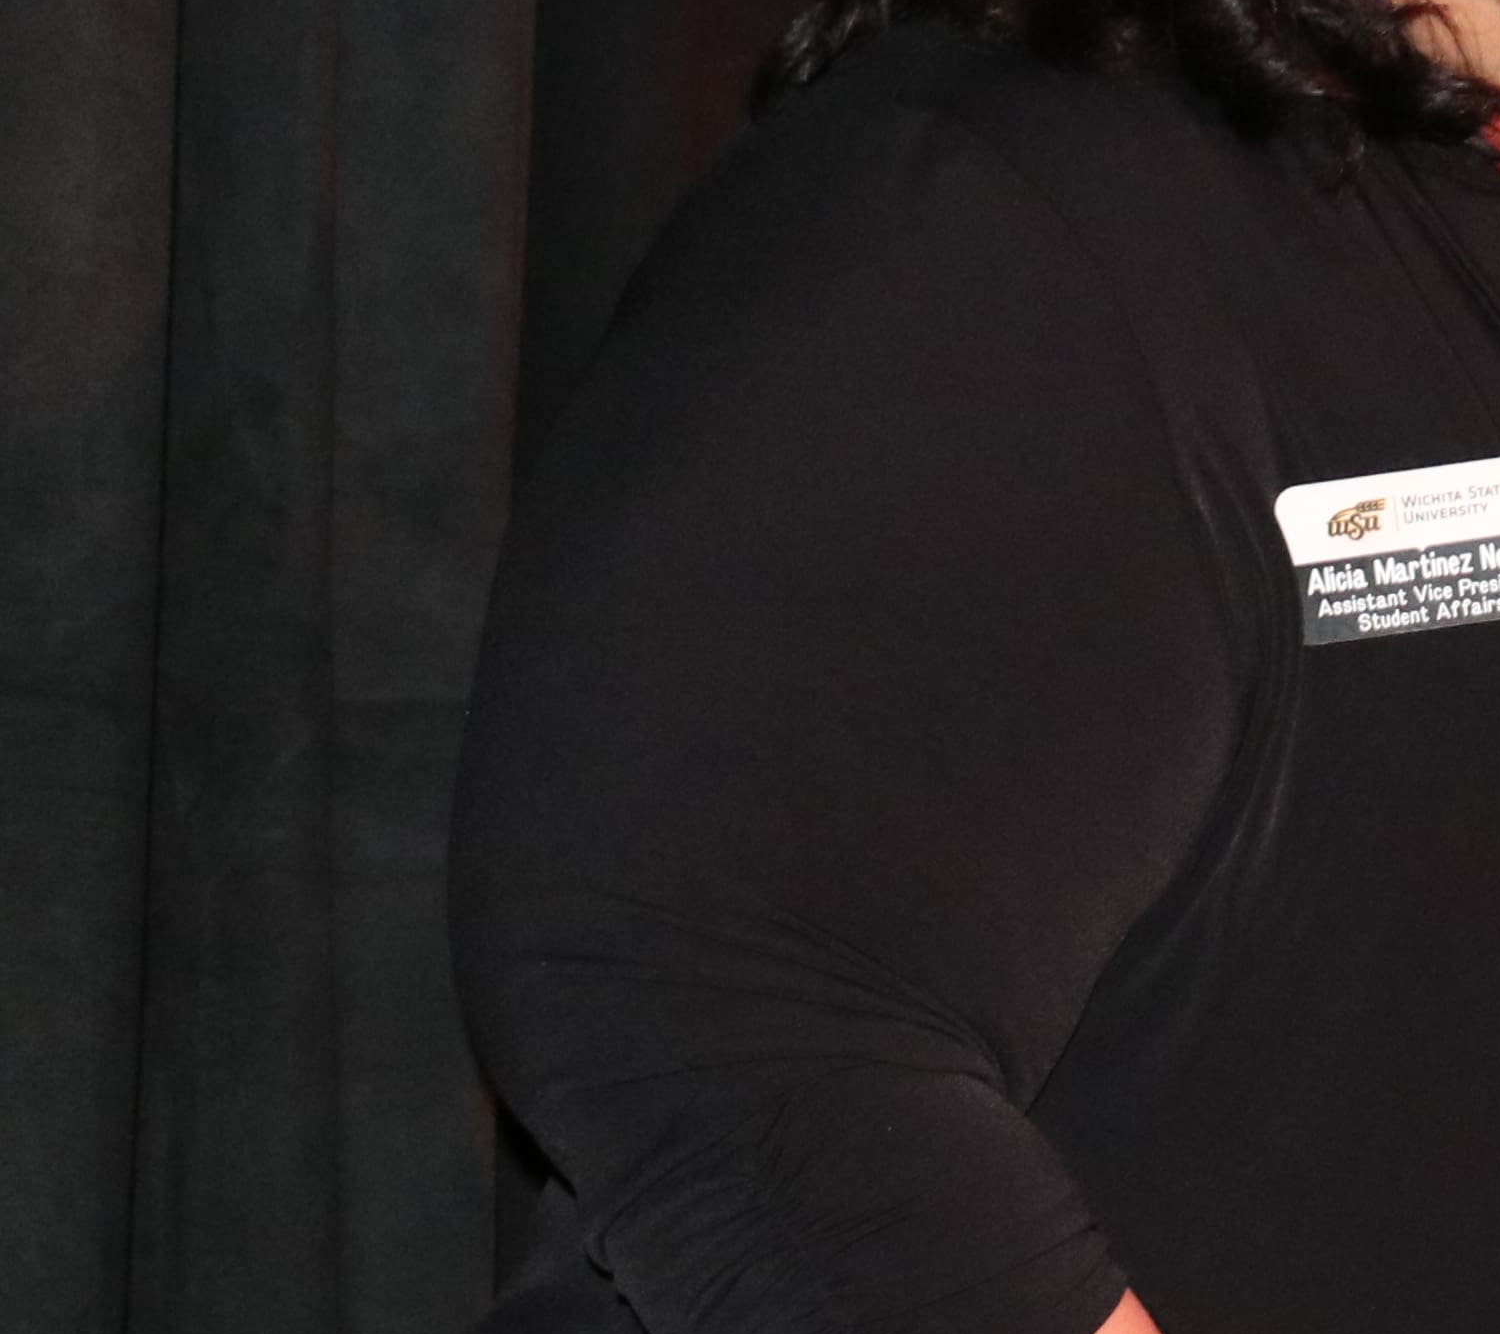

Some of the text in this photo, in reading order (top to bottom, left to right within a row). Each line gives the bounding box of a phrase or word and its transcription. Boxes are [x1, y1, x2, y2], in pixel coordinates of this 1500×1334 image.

[1400, 489, 1463, 509] WICHITA
[1402, 502, 1488, 525] UNIVERSITY
[1307, 563, 1369, 597] Alicia
[1373, 548, 1474, 586] Martinez
[1317, 588, 1408, 619] Assistant
[1413, 582, 1453, 604] Vice
[1358, 605, 1431, 633] Student
